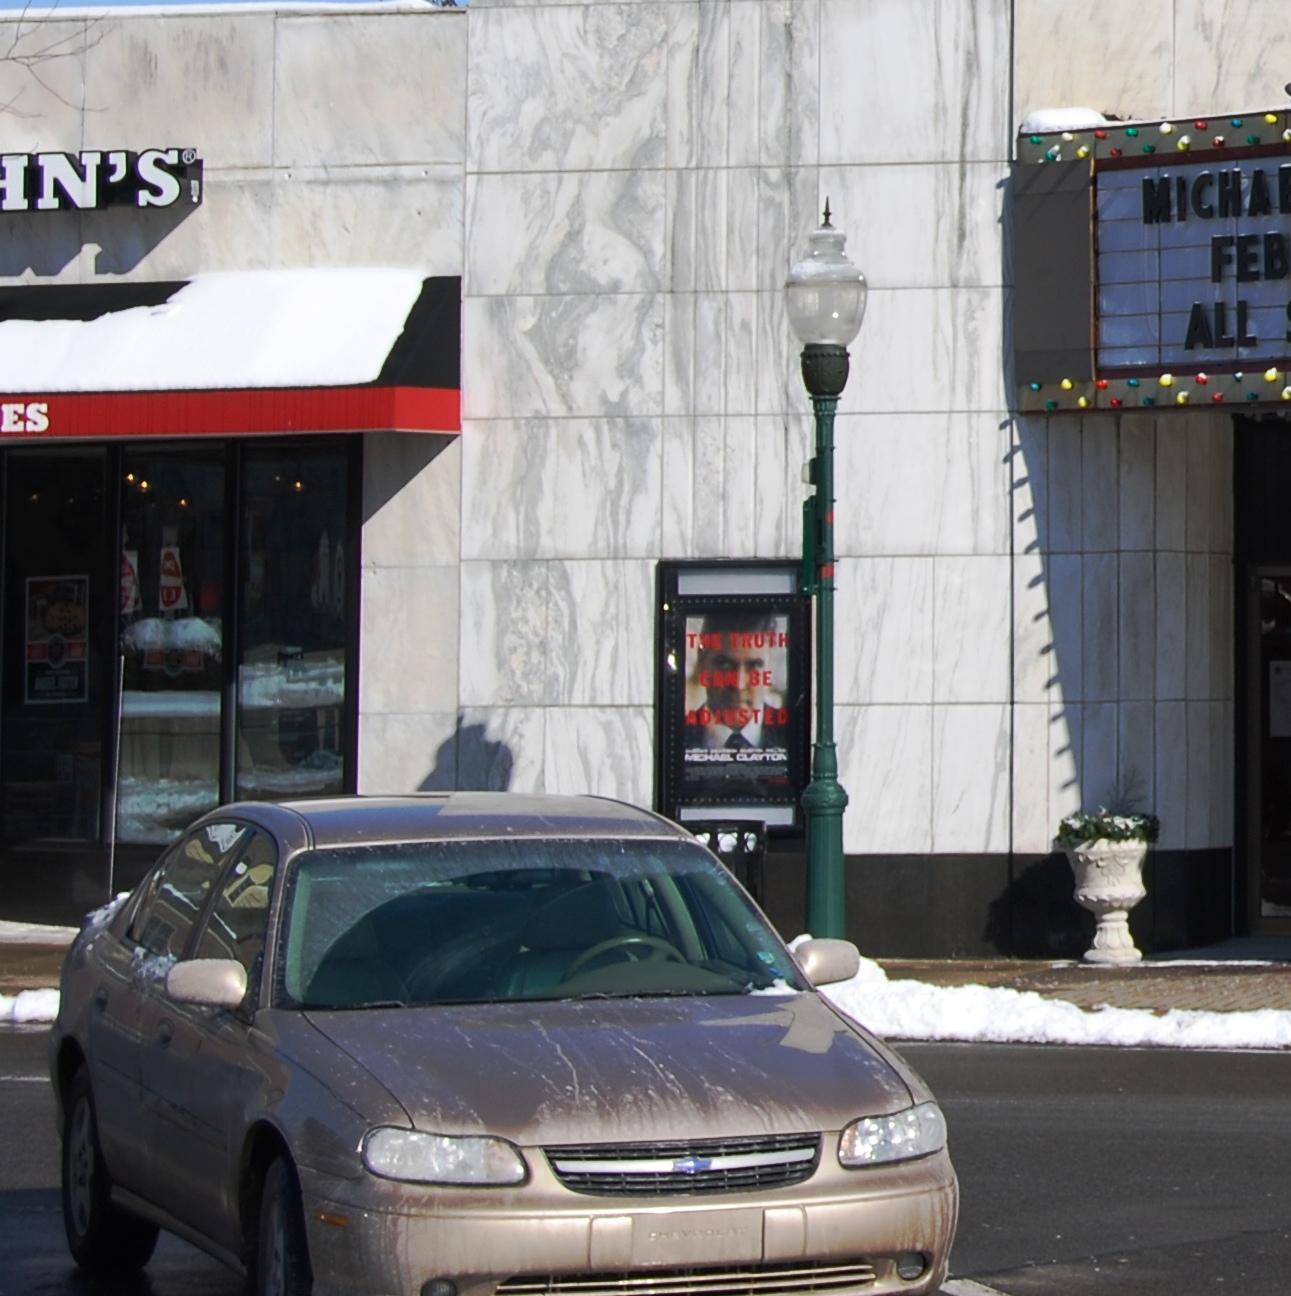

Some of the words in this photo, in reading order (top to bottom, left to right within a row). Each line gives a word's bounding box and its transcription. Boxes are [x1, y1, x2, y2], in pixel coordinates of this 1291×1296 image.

[1211, 230, 1290, 283] FEB
[1184, 301, 1258, 351] ALL
[687, 632, 722, 650] THE
[731, 631, 789, 649] TRUTH
[699, 671, 740, 688] CAN
[749, 670, 773, 686] BE
[685, 707, 789, 726] ADJUSTED
[684, 753, 734, 762] MICHAEL
[736, 753, 787, 762] CLAYTON
